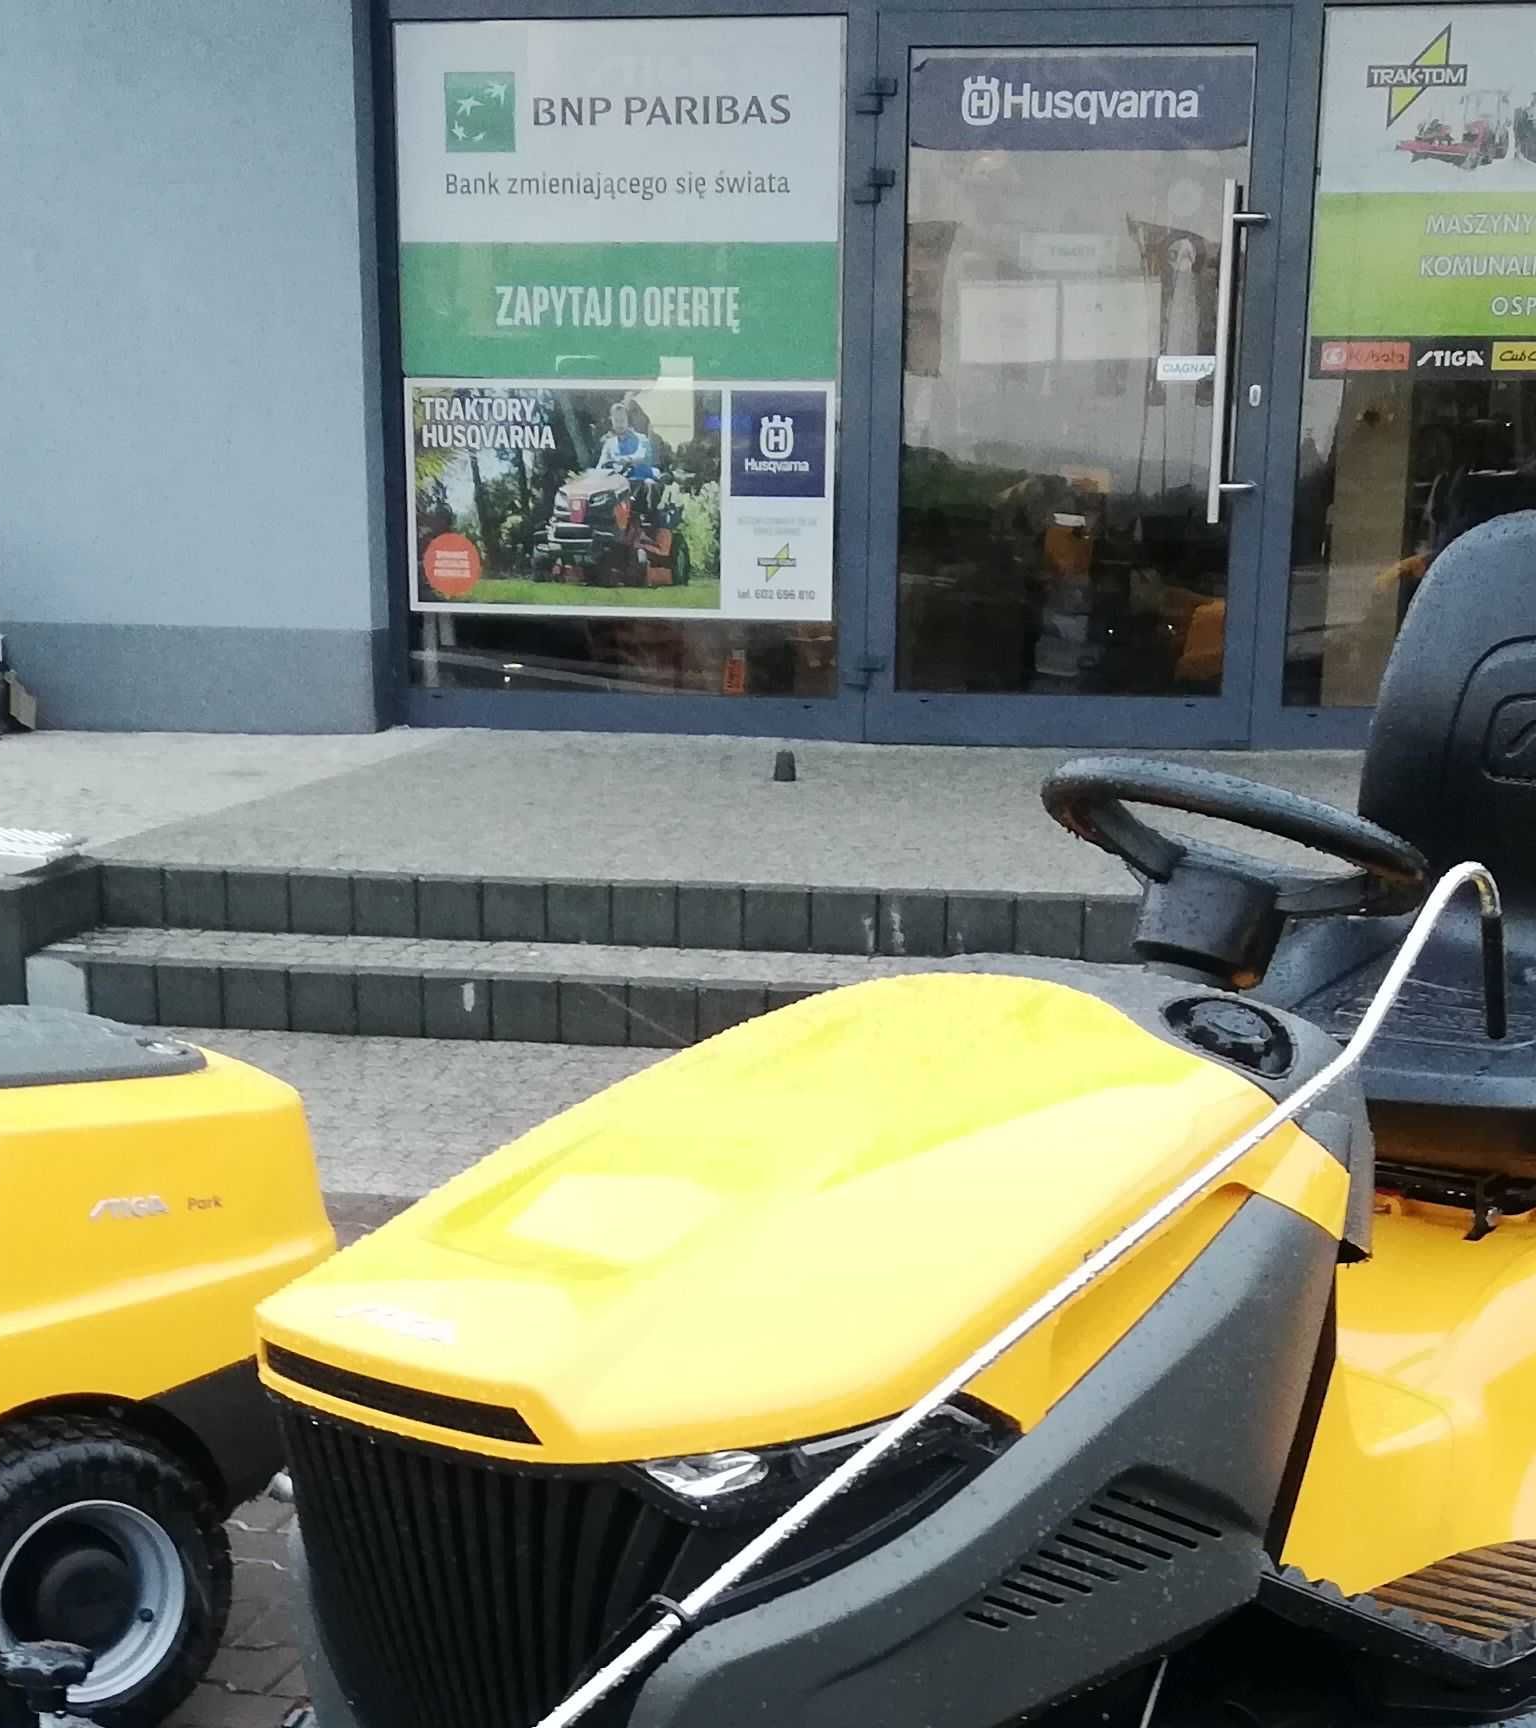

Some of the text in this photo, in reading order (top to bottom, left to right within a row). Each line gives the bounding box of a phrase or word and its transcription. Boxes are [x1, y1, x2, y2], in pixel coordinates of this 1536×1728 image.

[532, 93, 792, 127] BNP PARIBAS
[1003, 82, 1200, 125] Husqvarna
[445, 169, 791, 201] Bank zmieniającego się świata
[1425, 212, 1536, 235] MASZYNY
[495, 285, 741, 334] ZAPYTAJ O OFERTĘ
[1416, 350, 1484, 367] STIGA
[1498, 350, 1528, 362] Cub
[420, 397, 537, 424] TRAKTORY
[420, 424, 556, 451] HUSQVARNA
[744, 457, 810, 475] Husqvarna
